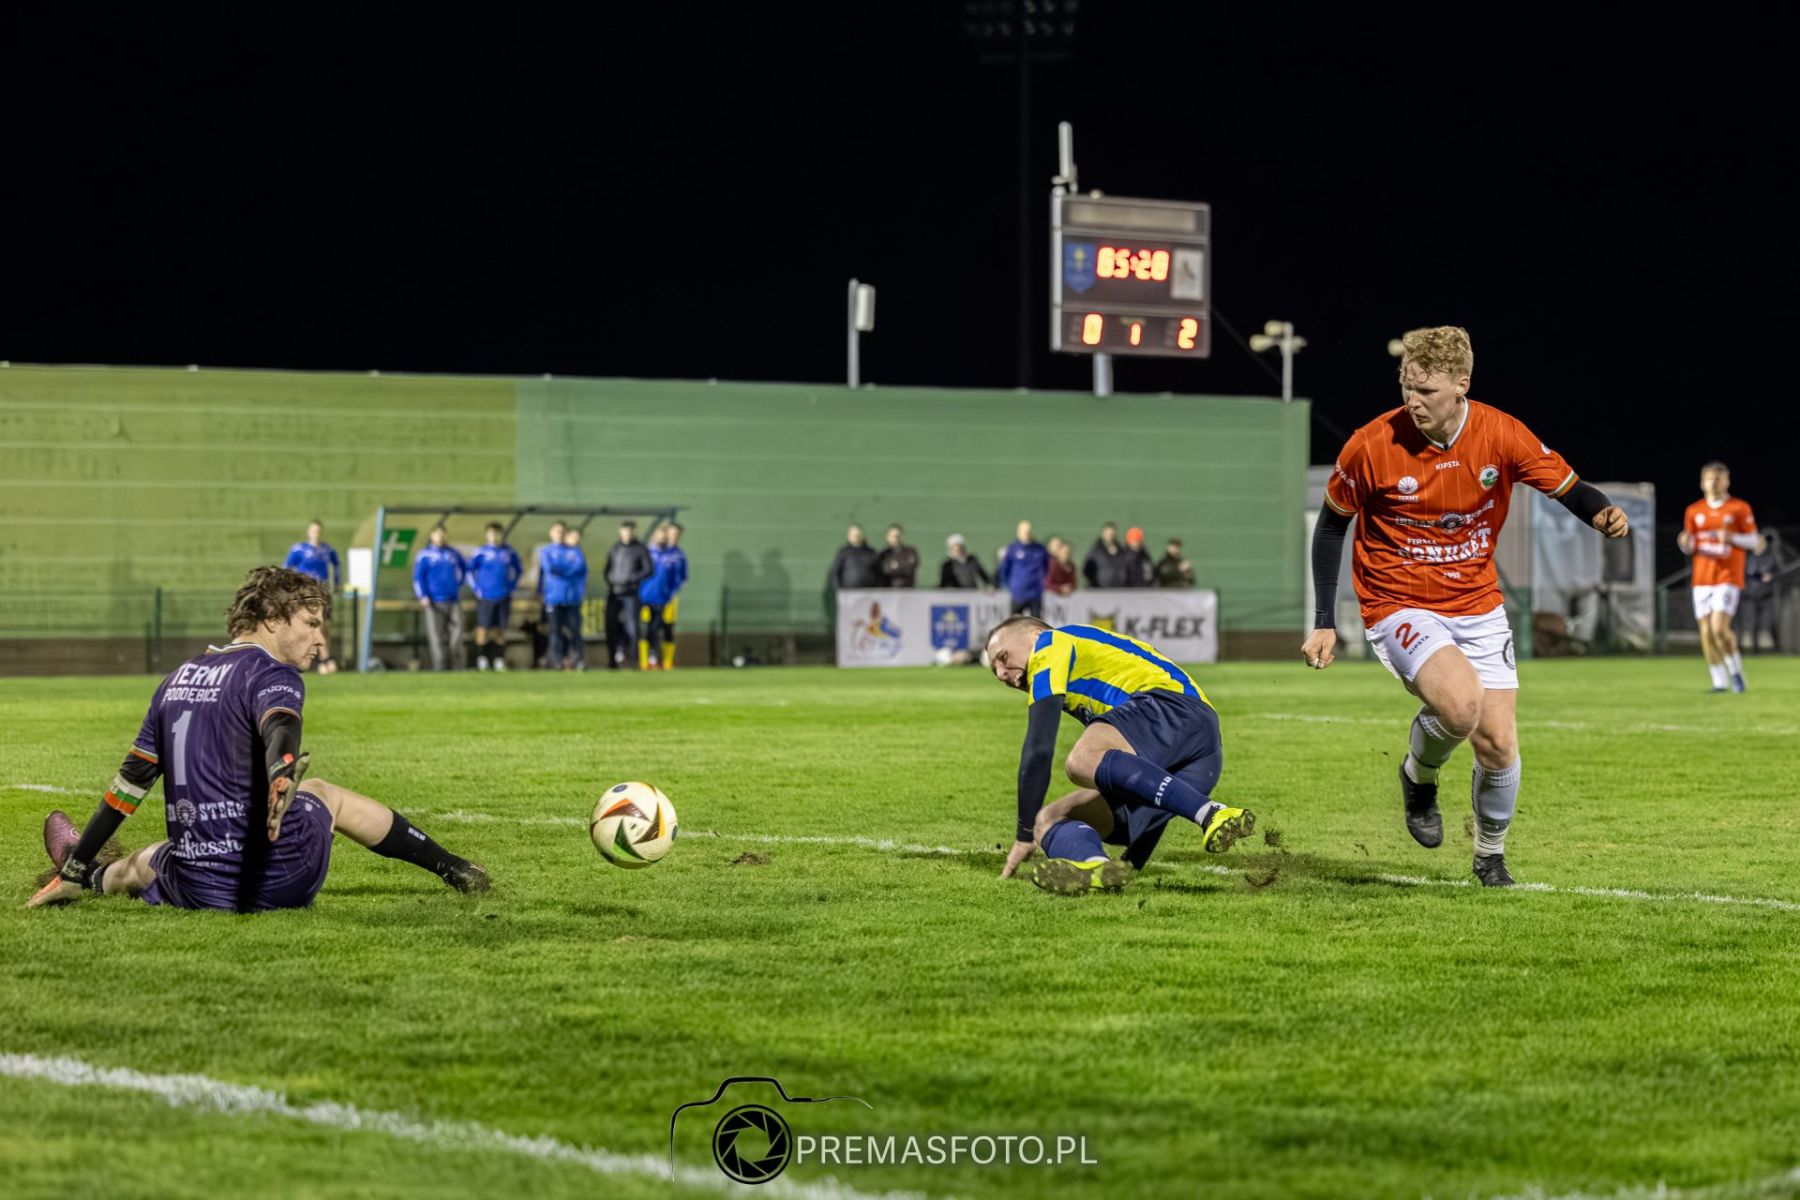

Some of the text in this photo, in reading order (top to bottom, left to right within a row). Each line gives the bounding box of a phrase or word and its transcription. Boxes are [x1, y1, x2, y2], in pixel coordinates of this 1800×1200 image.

[1096, 246, 1170, 281] 05:20
[1082, 313, 1104, 345] 0
[1129, 322, 1142, 346] 1
[1177, 318, 1199, 350] 2
[1435, 460, 1461, 471] KIPSTA
[1123, 615, 1206, 639] K-FLEX
[1395, 622, 1421, 650] 2
[172, 710, 192, 786] 1
